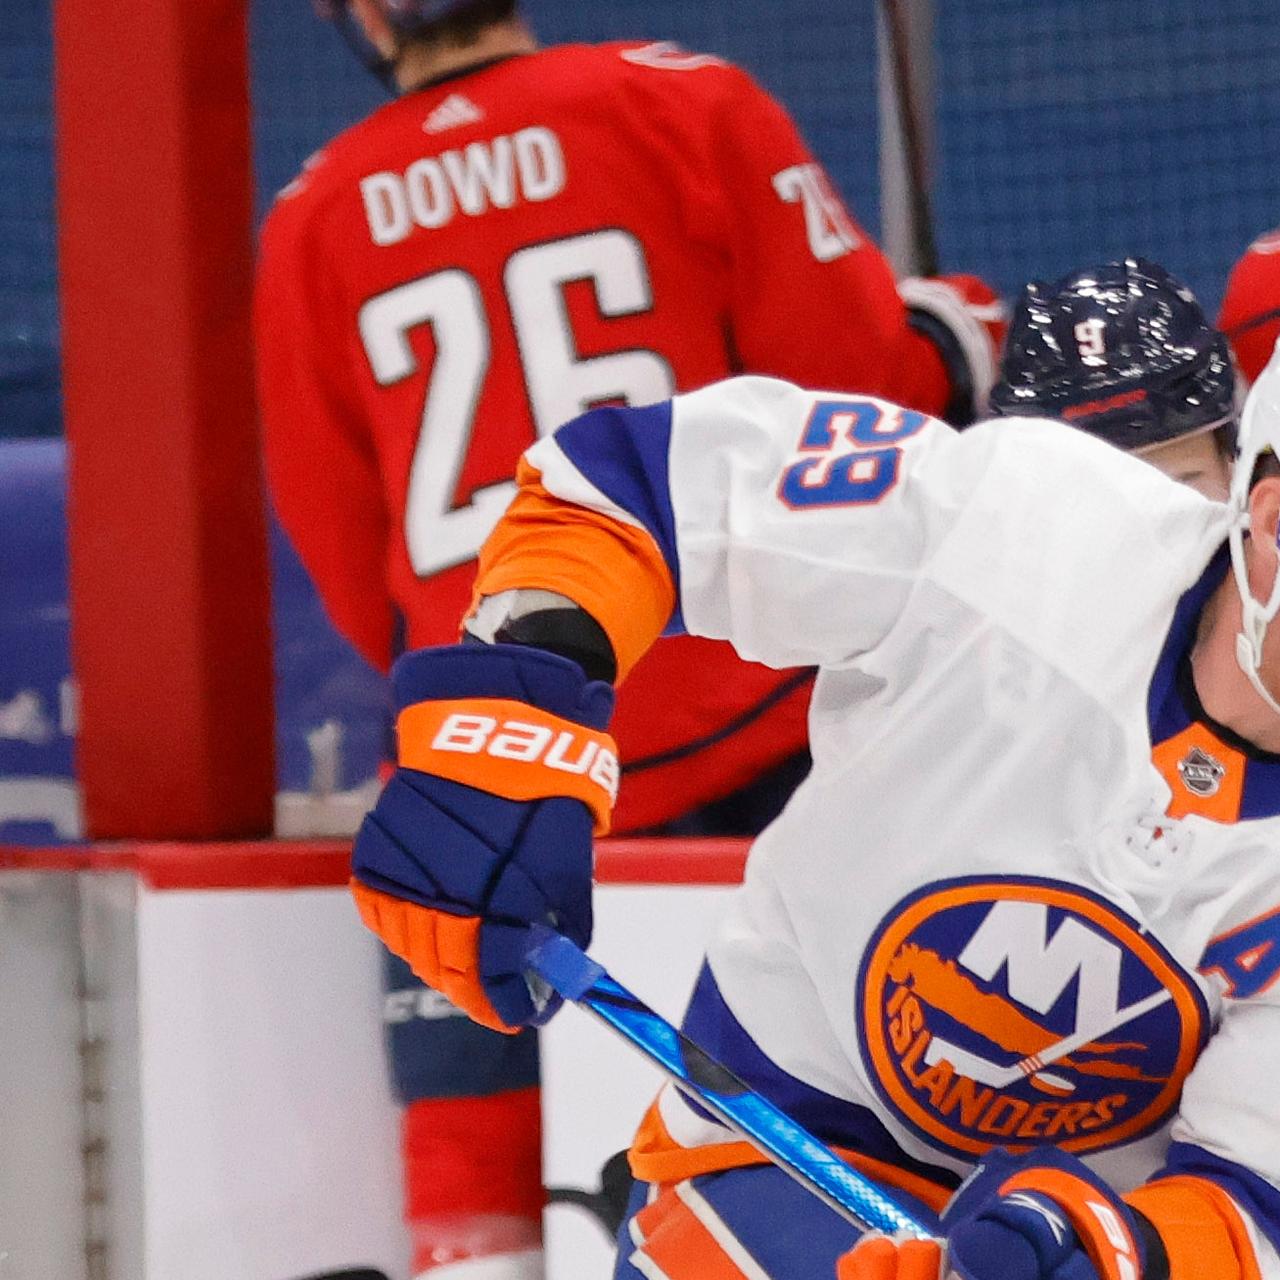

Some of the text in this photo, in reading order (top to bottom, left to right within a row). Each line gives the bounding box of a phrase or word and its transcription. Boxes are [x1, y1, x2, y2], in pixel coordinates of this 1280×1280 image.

[359, 126, 567, 247] DOWD
[358, 227, 677, 578] 26
[1072, 318, 1106, 366] 9
[776, 400, 937, 511] 29
[886, 984, 1128, 1138] ISLANDERS
